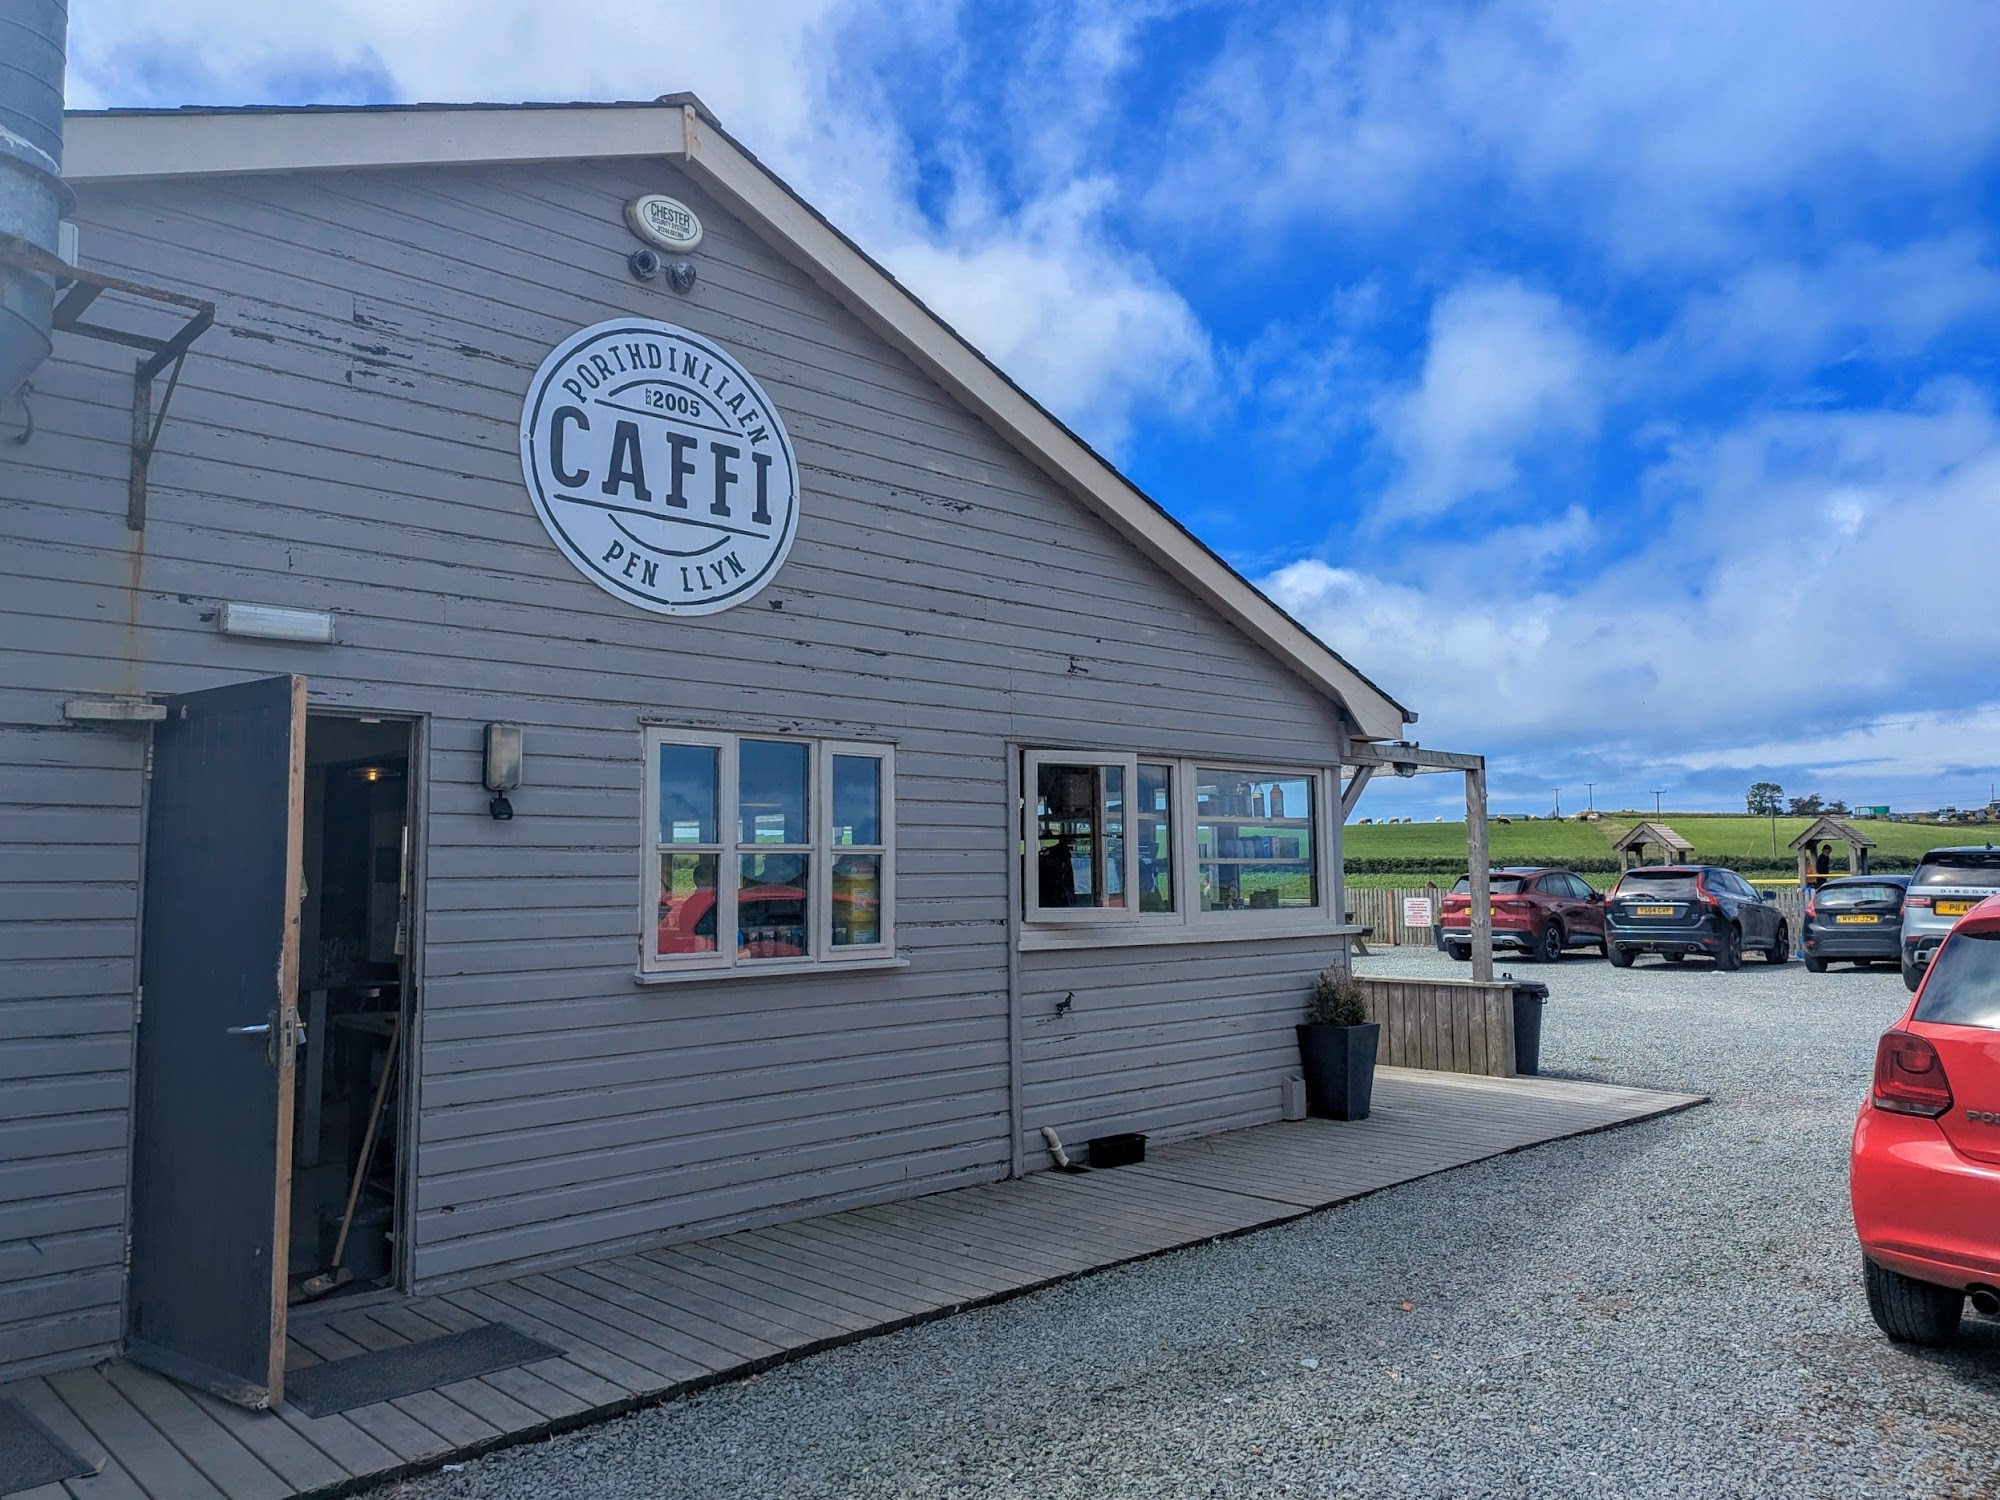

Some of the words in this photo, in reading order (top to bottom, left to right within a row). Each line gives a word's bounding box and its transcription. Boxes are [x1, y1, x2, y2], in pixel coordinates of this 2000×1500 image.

[651, 203, 690, 228] CHESTER
[562, 343, 769, 446] PORTHDINLLAEN
[653, 390, 700, 417] 2005
[551, 405, 772, 525] CAFFI
[602, 539, 660, 588] PEN
[680, 551, 746, 592] LLYN
